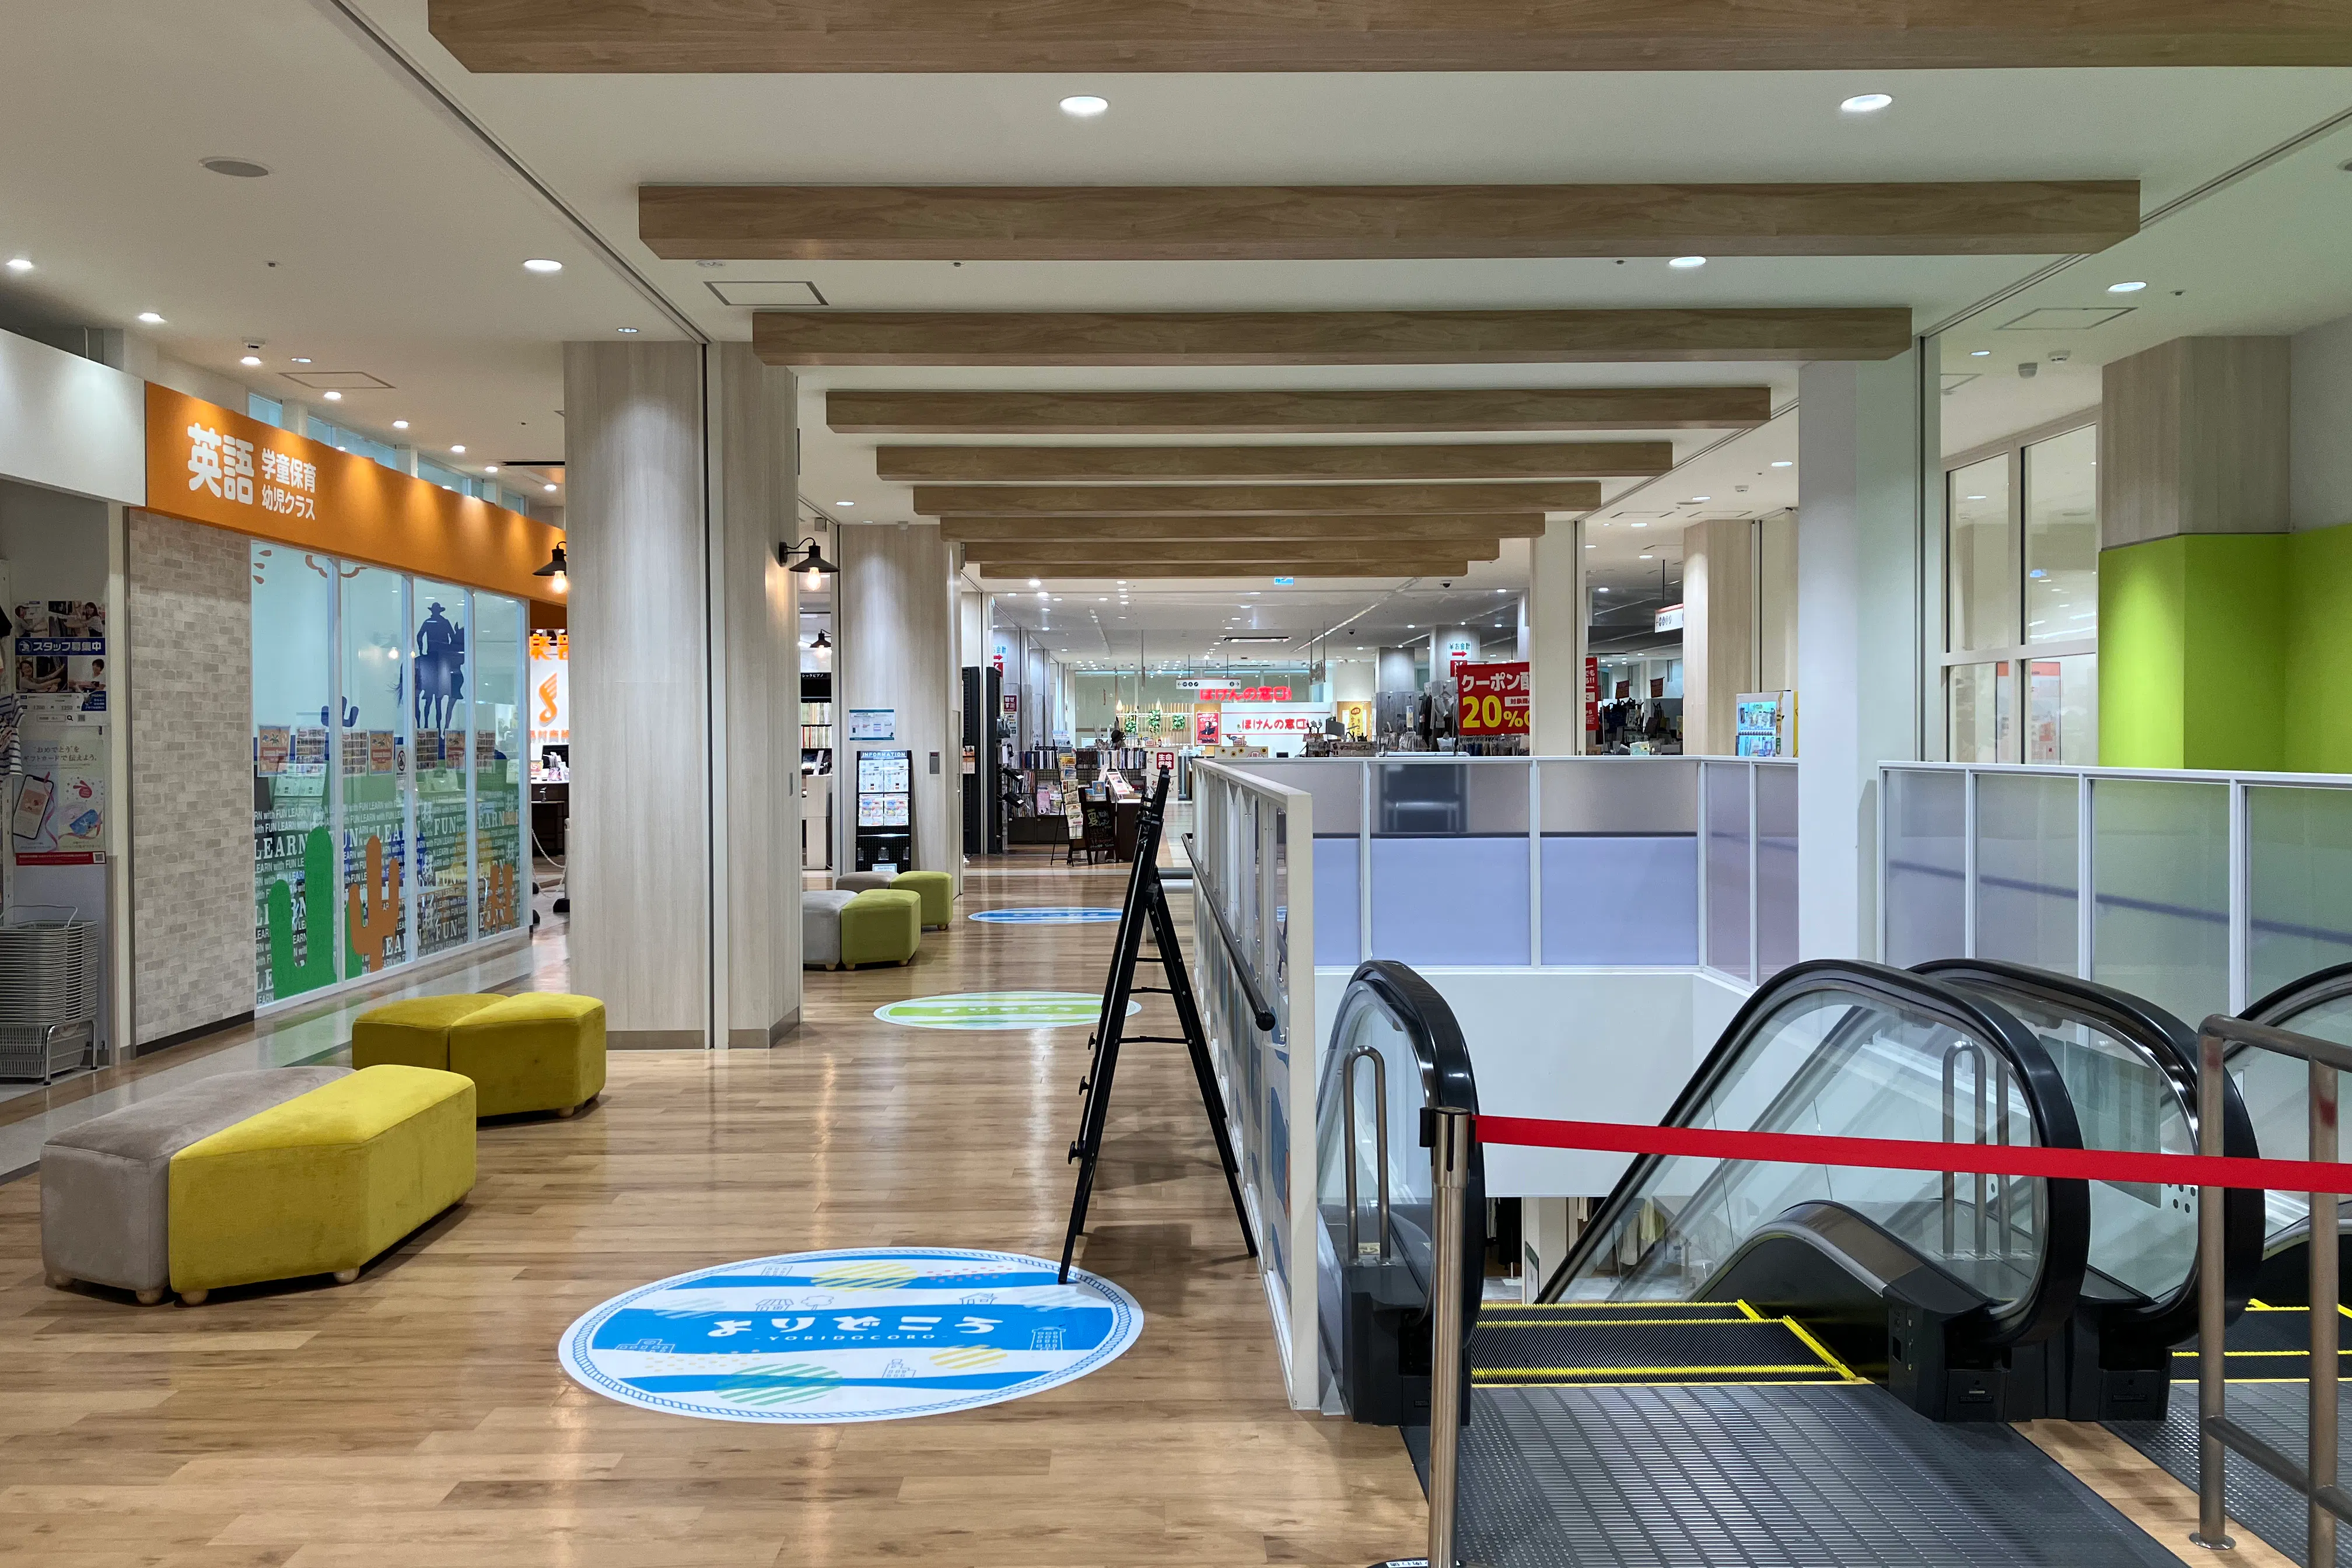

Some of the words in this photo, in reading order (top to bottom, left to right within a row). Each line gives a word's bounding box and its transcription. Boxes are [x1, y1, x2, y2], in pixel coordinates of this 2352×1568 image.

[187, 422, 254, 506] 英語
[261, 447, 316, 493] 学童保育
[261, 484, 316, 520] 幼児クラス
[33, 642, 102, 652] スタッフ募集中
[1199, 686, 1290, 701] ほけんの窓口
[1242, 718, 1306, 730] ほけんの窓口
[276, 808, 287, 818] FUN
[478, 811, 505, 829] EARN
[265, 822, 276, 832] FUN
[278, 821, 297, 831] LEARN
[434, 817, 456, 835] FUN
[256, 862, 272, 873] EARN
[436, 919, 457, 941] FUN
[708, 1316, 1003, 1337] よりどころ
